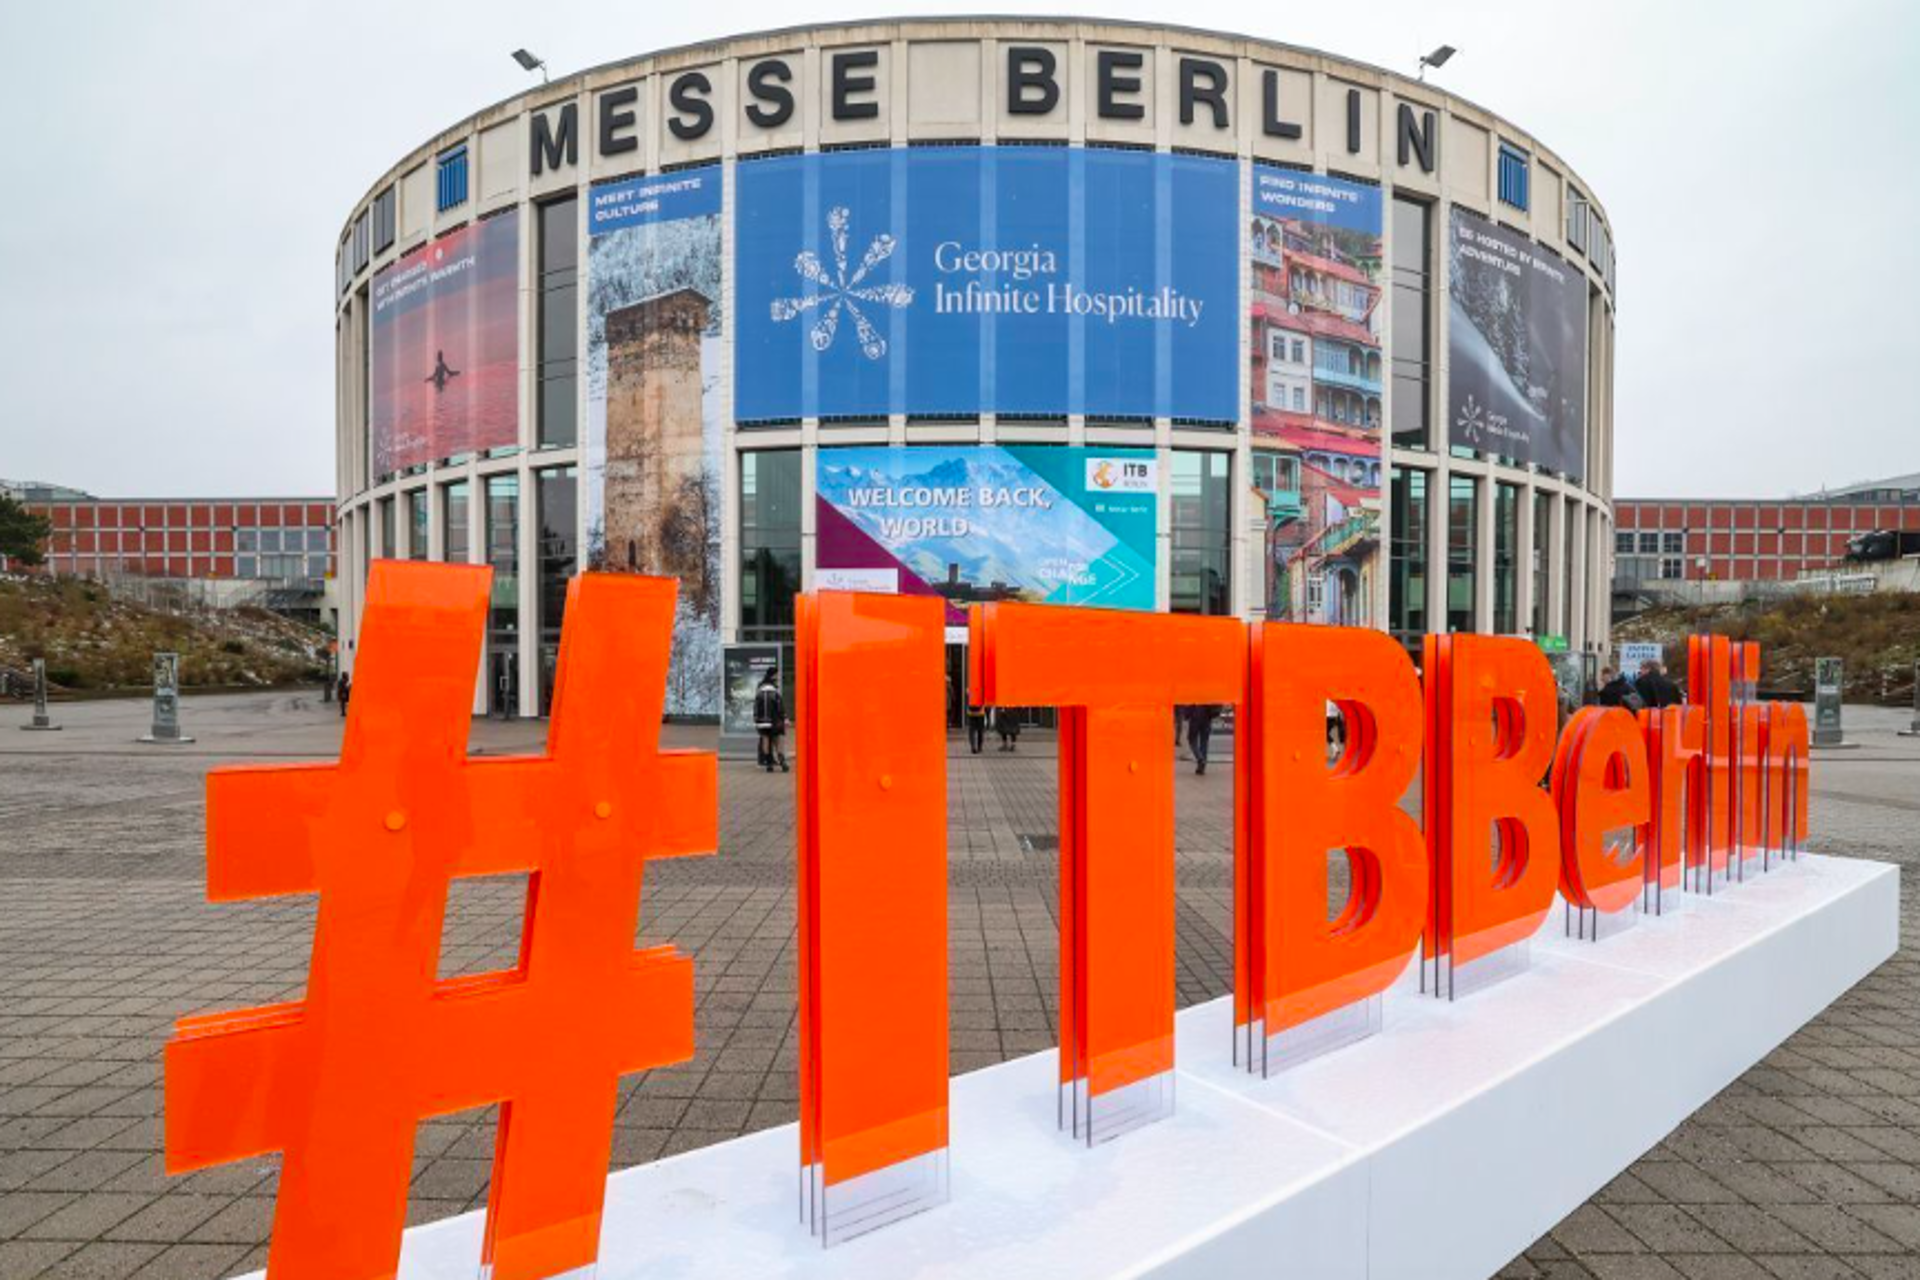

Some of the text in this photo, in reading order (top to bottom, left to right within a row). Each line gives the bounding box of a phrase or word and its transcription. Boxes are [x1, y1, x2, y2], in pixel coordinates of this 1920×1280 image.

[530, 47, 1435, 175] MESSE BERLIN
[639, 178, 702, 198] INFINITE
[1299, 182, 1358, 203] INFINITE
[595, 200, 659, 221] CULTURE
[1261, 192, 1335, 212] WONDERS
[934, 242, 1056, 279] Georgia
[934, 282, 1204, 326] Infinite Hospitality
[1123, 462, 1148, 477] ITB
[848, 487, 1052, 510] WELCOME BACK,
[880, 518, 971, 538] WORLD
